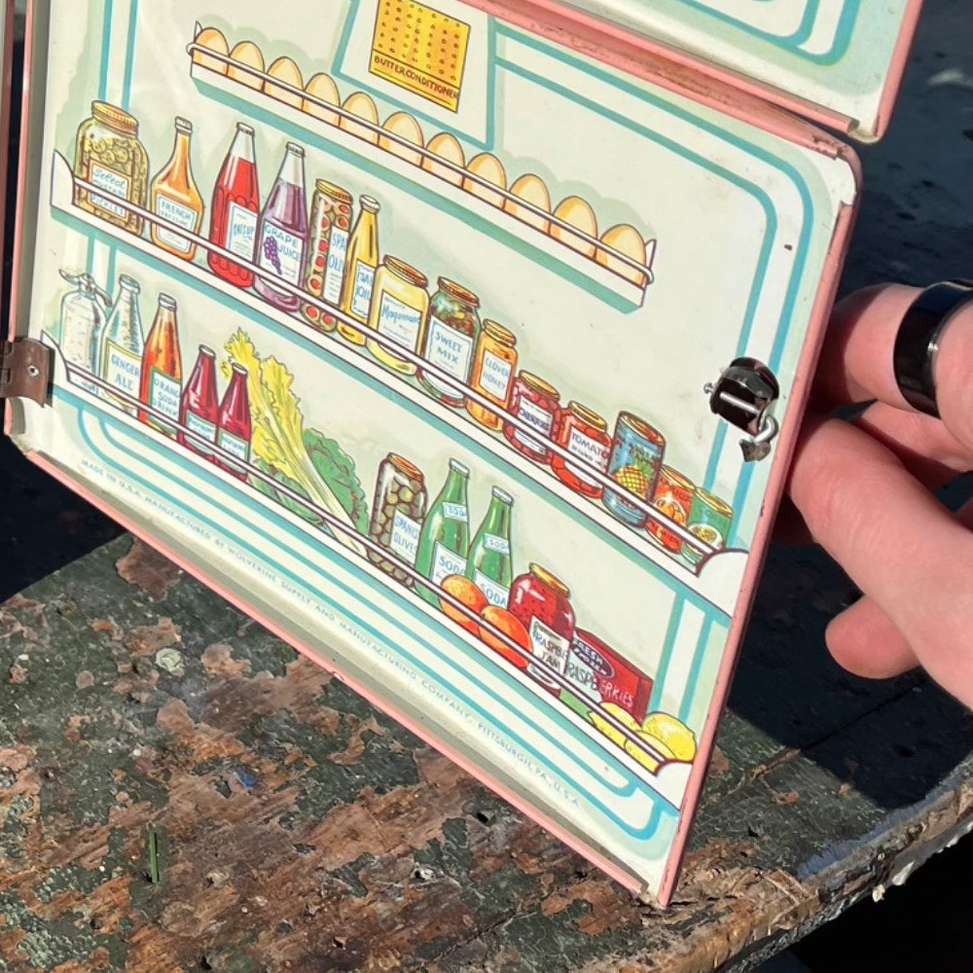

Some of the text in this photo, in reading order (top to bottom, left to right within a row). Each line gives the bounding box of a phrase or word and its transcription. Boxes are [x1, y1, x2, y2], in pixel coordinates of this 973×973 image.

[264, 224, 298, 247] GRAPE
[277, 244, 300, 262] JUICE
[435, 330, 462, 353] SWEET
[437, 346, 459, 364] MIX
[485, 358, 509, 377] CLOVER
[114, 374, 133, 391] ALE
[572, 432, 607, 459] TOMATO
[481, 583, 506, 606] SODA
